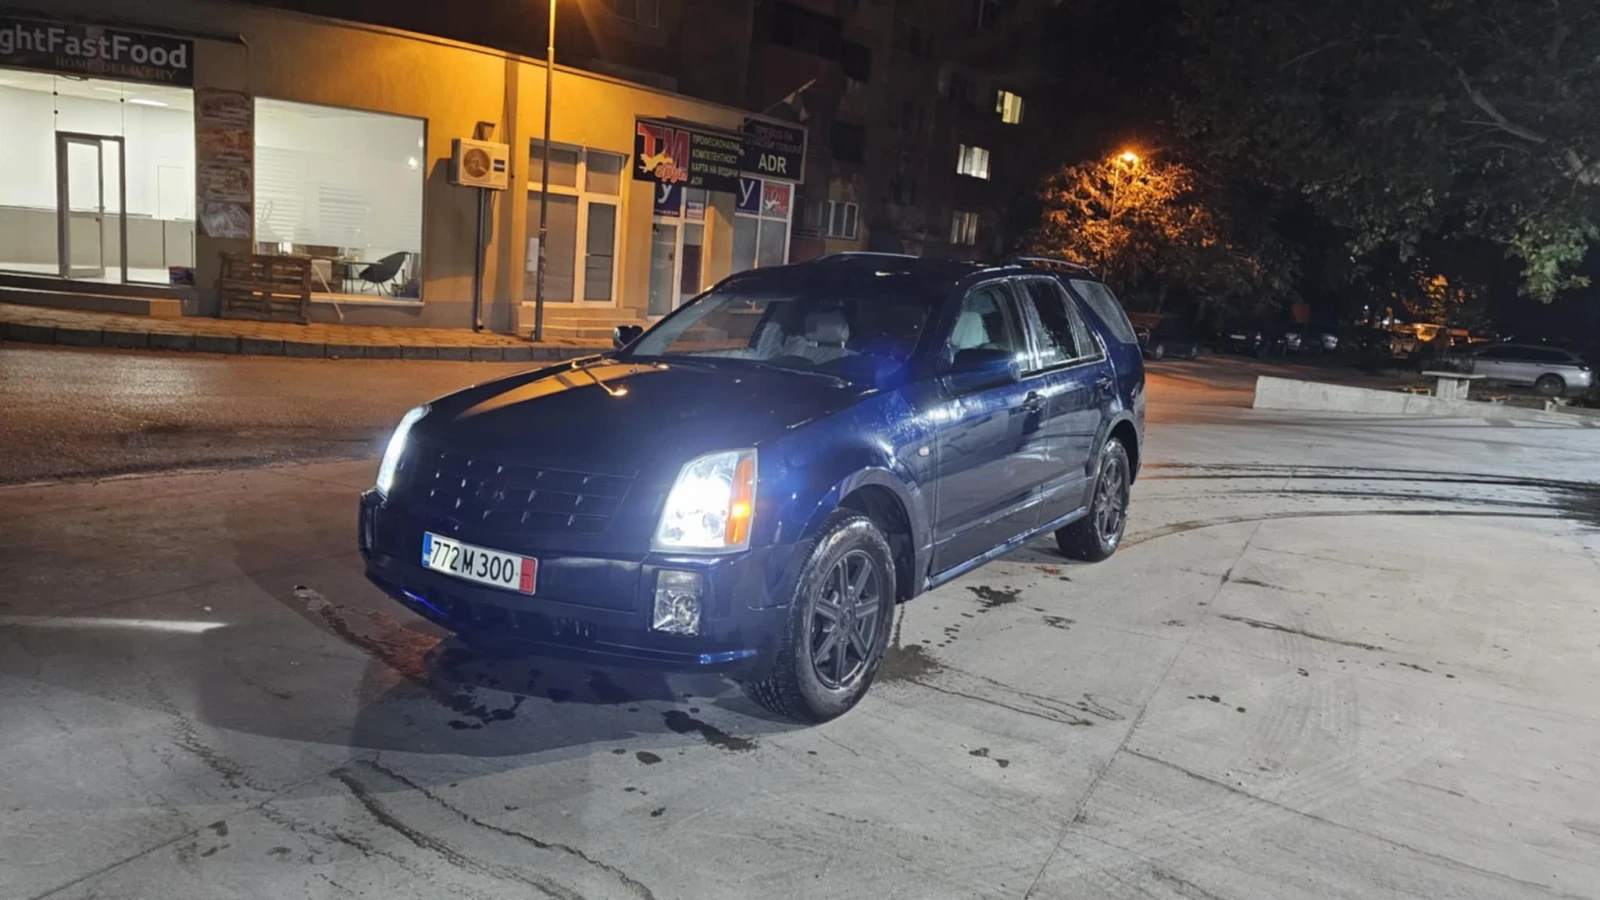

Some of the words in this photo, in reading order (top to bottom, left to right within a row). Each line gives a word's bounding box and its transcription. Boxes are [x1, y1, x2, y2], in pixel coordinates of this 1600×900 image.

[102, 63, 179, 81] DELIVERY
[758, 153, 787, 174] ADR
[431, 540, 460, 571] 772
[476, 552, 515, 584] 300
